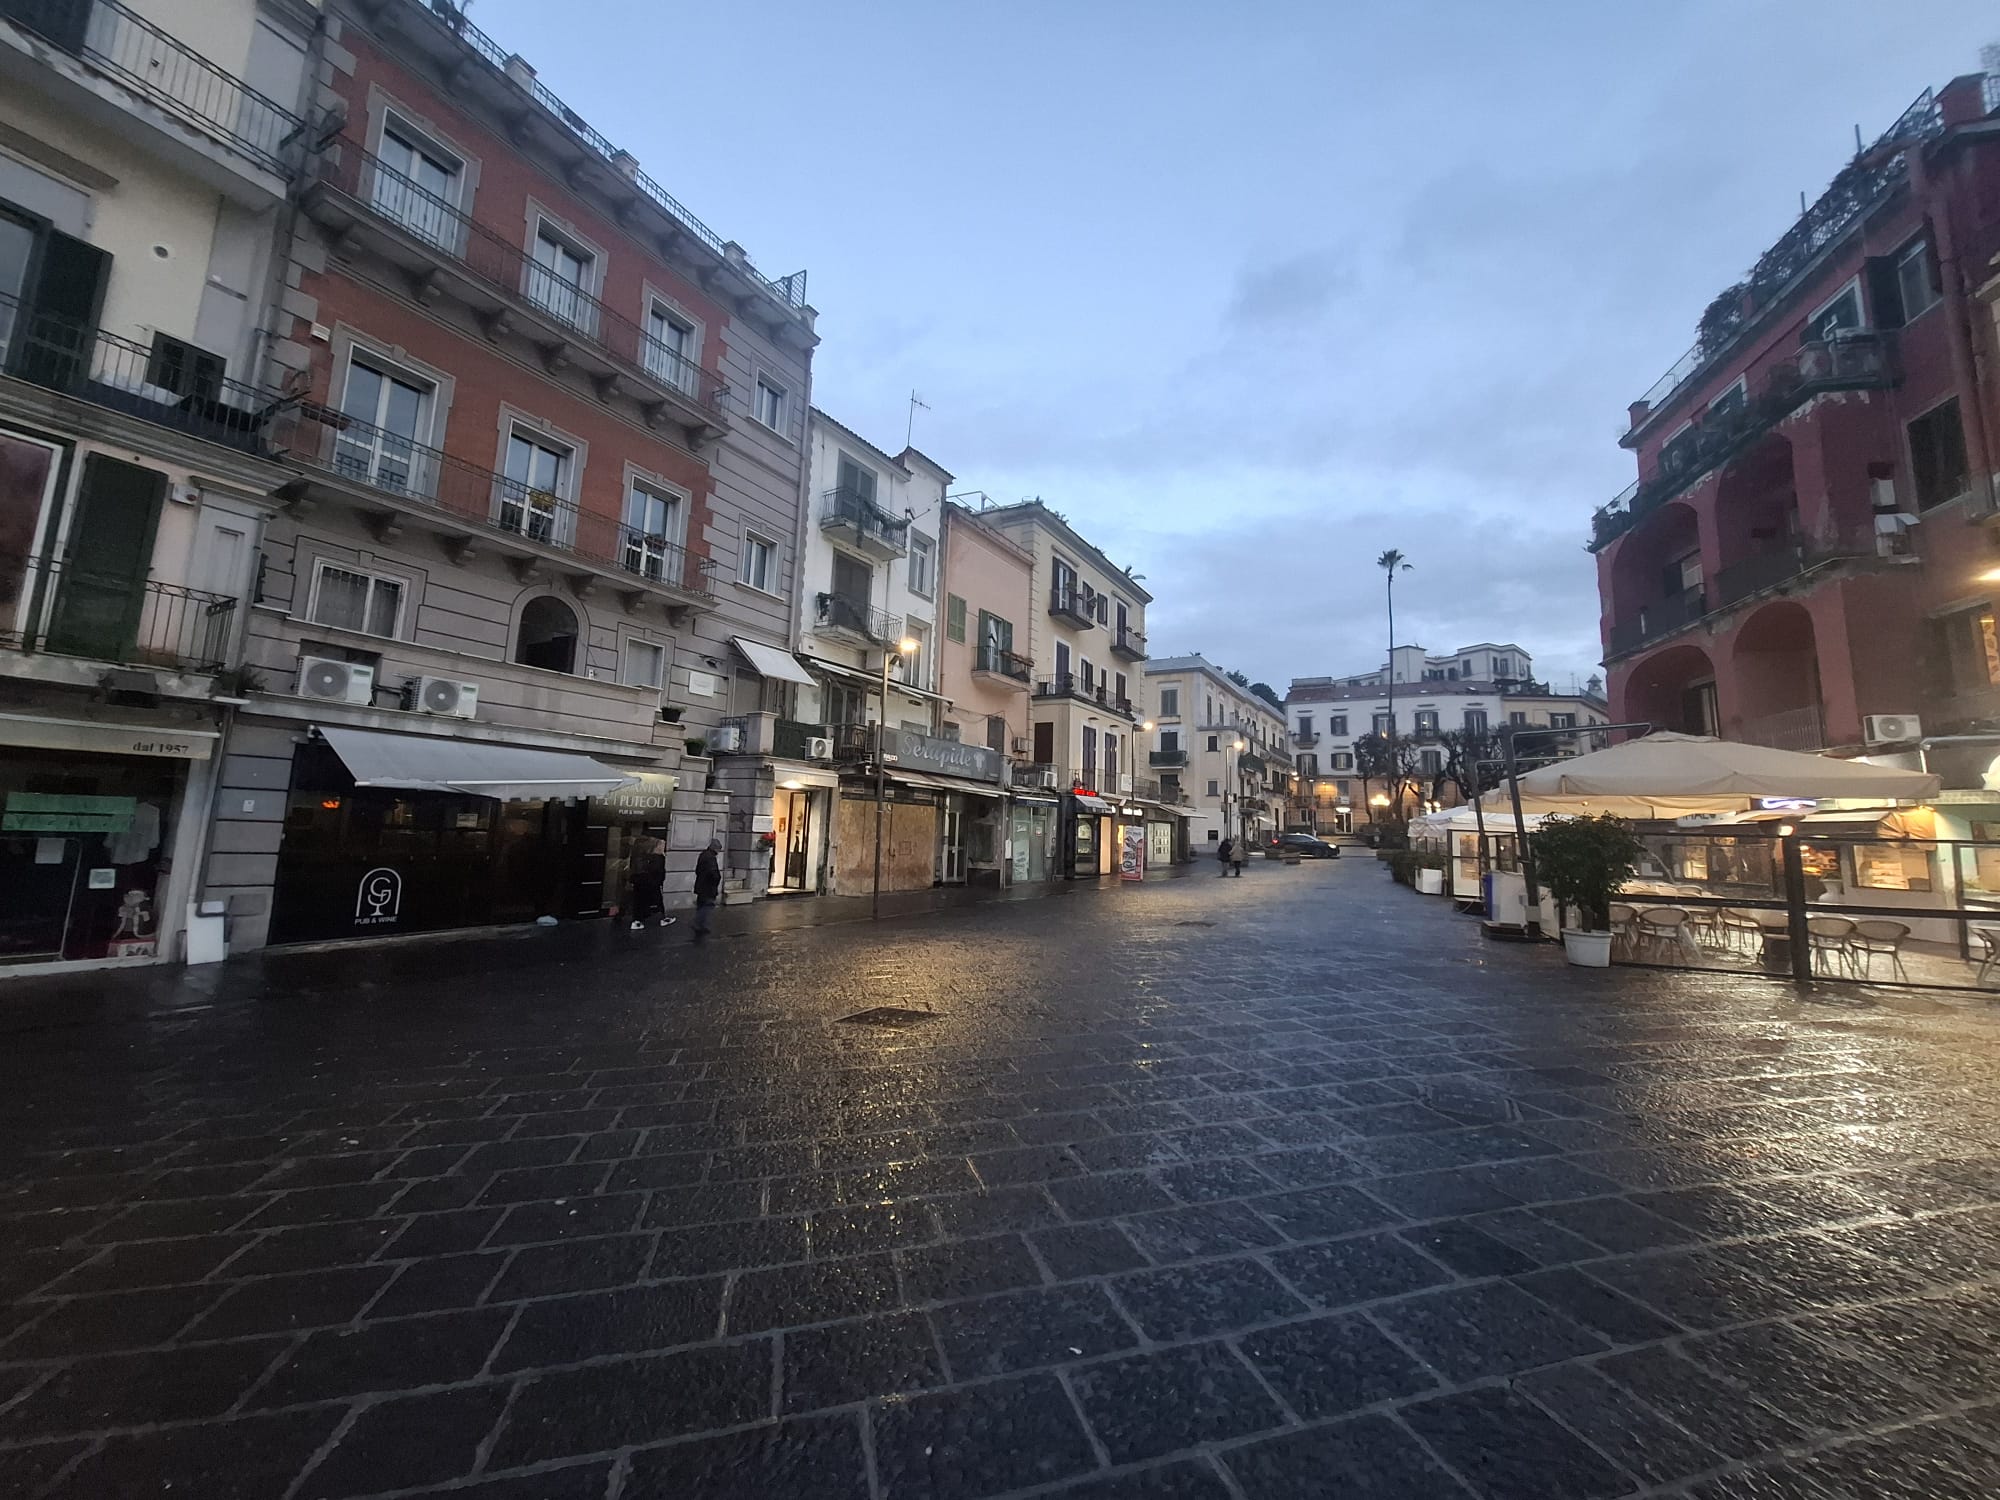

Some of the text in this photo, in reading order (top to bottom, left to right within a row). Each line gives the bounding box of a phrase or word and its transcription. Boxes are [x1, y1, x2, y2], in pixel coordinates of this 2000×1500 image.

[160, 744, 189, 753] 1957
[902, 736, 971, 767] Serapide
[620, 795, 666, 808] PUTEOLI
